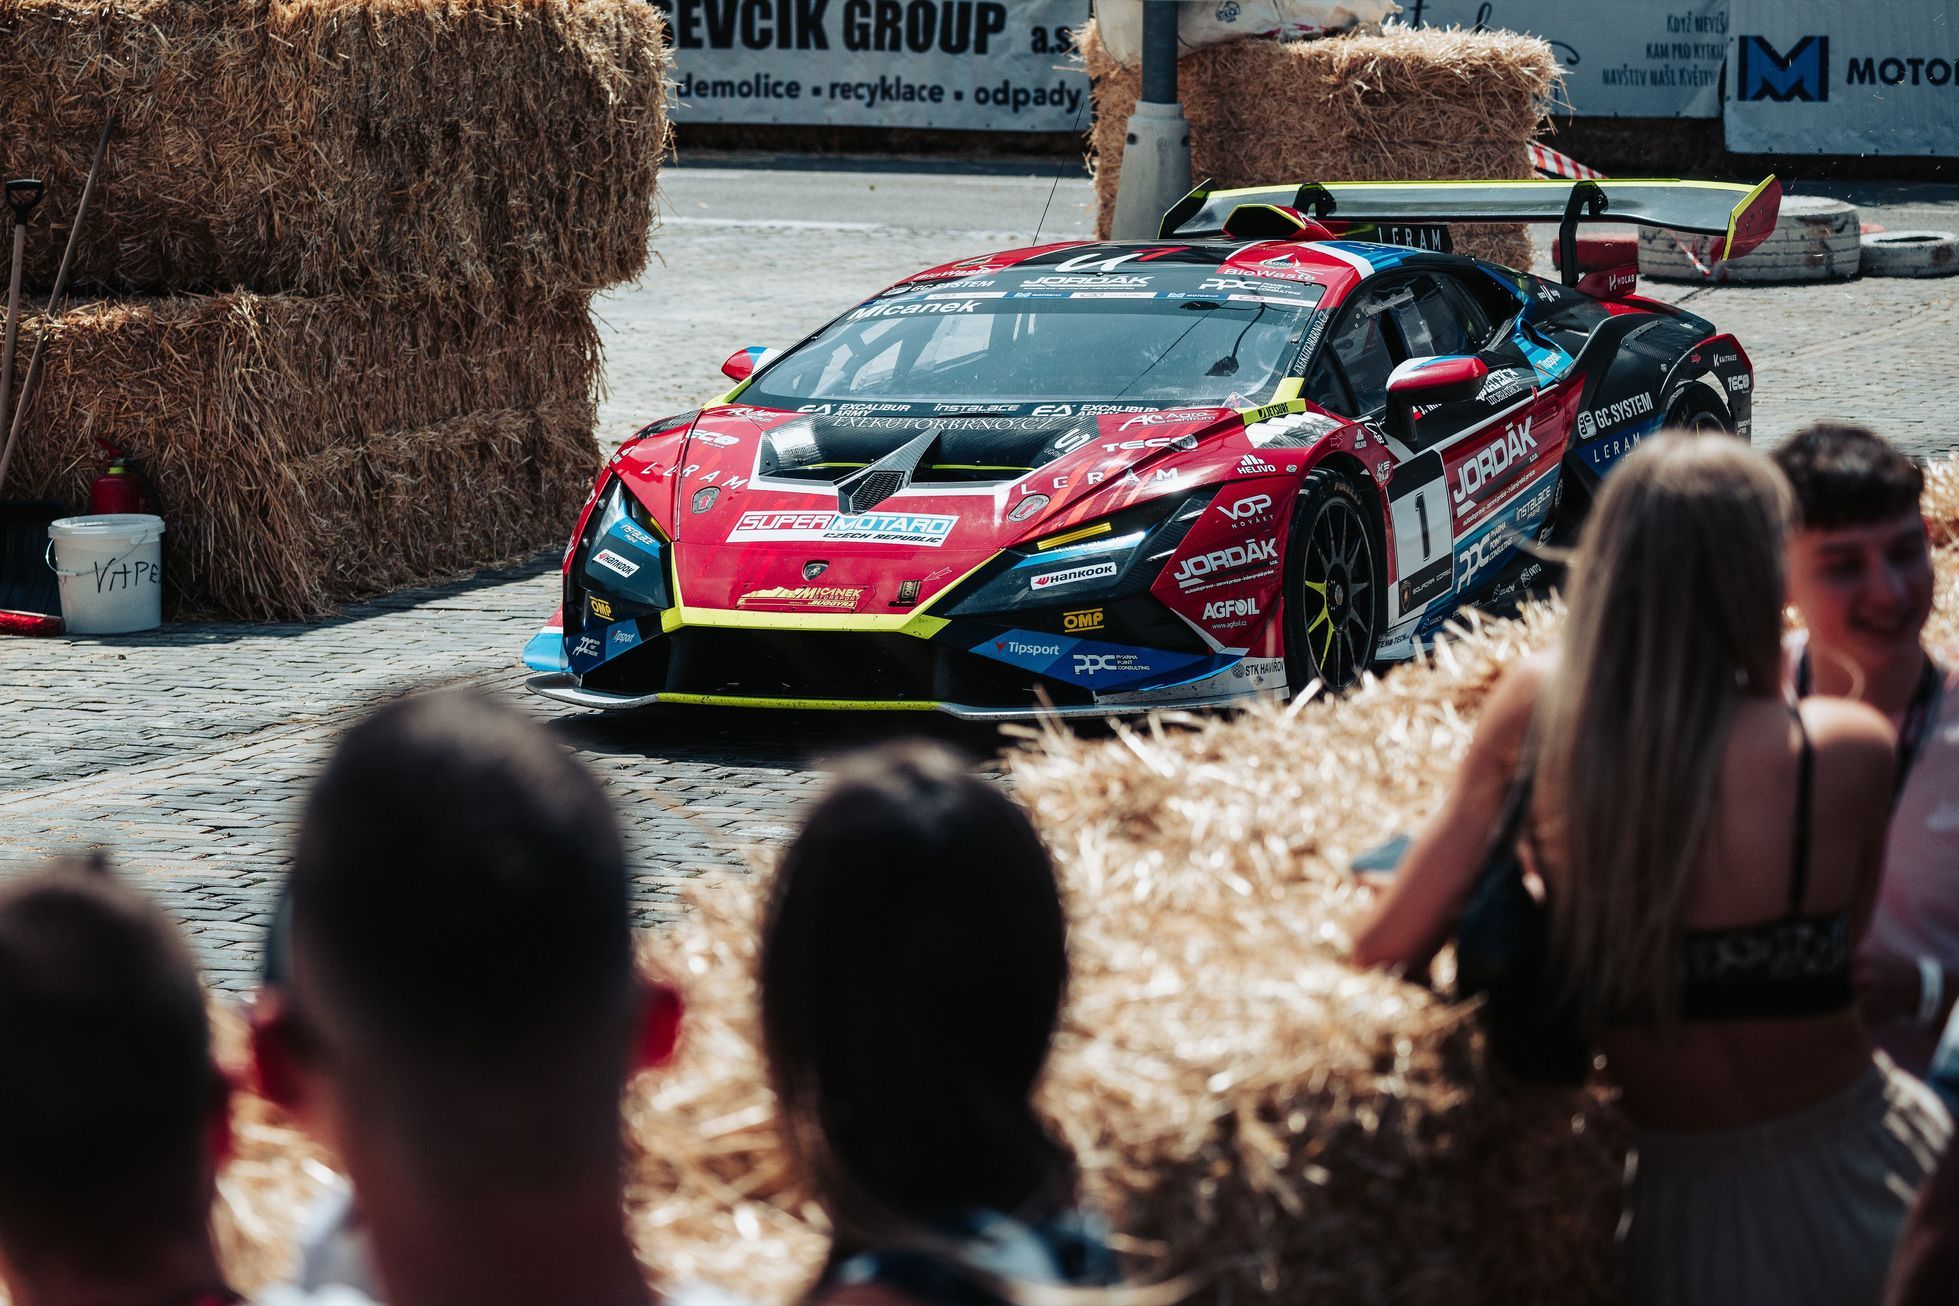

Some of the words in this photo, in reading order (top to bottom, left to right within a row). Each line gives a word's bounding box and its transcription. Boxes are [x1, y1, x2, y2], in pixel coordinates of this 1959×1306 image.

[844, 0, 1006, 55] GROUP
[678, 74, 801, 98] demolice
[829, 76, 944, 107] recyklace
[974, 80, 1082, 113] odpady
[846, 299, 984, 321] Micanek
[840, 403, 911, 411] EXCALIBUR
[1594, 407, 1612, 429] GC
[1611, 391, 1654, 423] SYSTEM
[1236, 464, 1277, 475] HELIVO
[1453, 415, 1538, 504] JORDÁK
[1020, 467, 1178, 496] LERAM
[1216, 493, 1272, 521] VOP
[1231, 514, 1274, 529] NOVÁKY
[1415, 491, 1431, 562] 1
[823, 532, 871, 540] CZECH
[873, 533, 942, 543] REPUBLIC
[1174, 537, 1278, 581] JORDÁK
[1457, 533, 1490, 595] PPC
[591, 600, 612, 617] OMP
[1202, 597, 1260, 620] AGFOIL
[1063, 612, 1104, 629] OMP
[1212, 620, 1247, 629] www.agfoil.cz
[1008, 641, 1060, 656] Tipsport
[1073, 654, 1117, 675] PPC
[1245, 664, 1259, 677] STK
